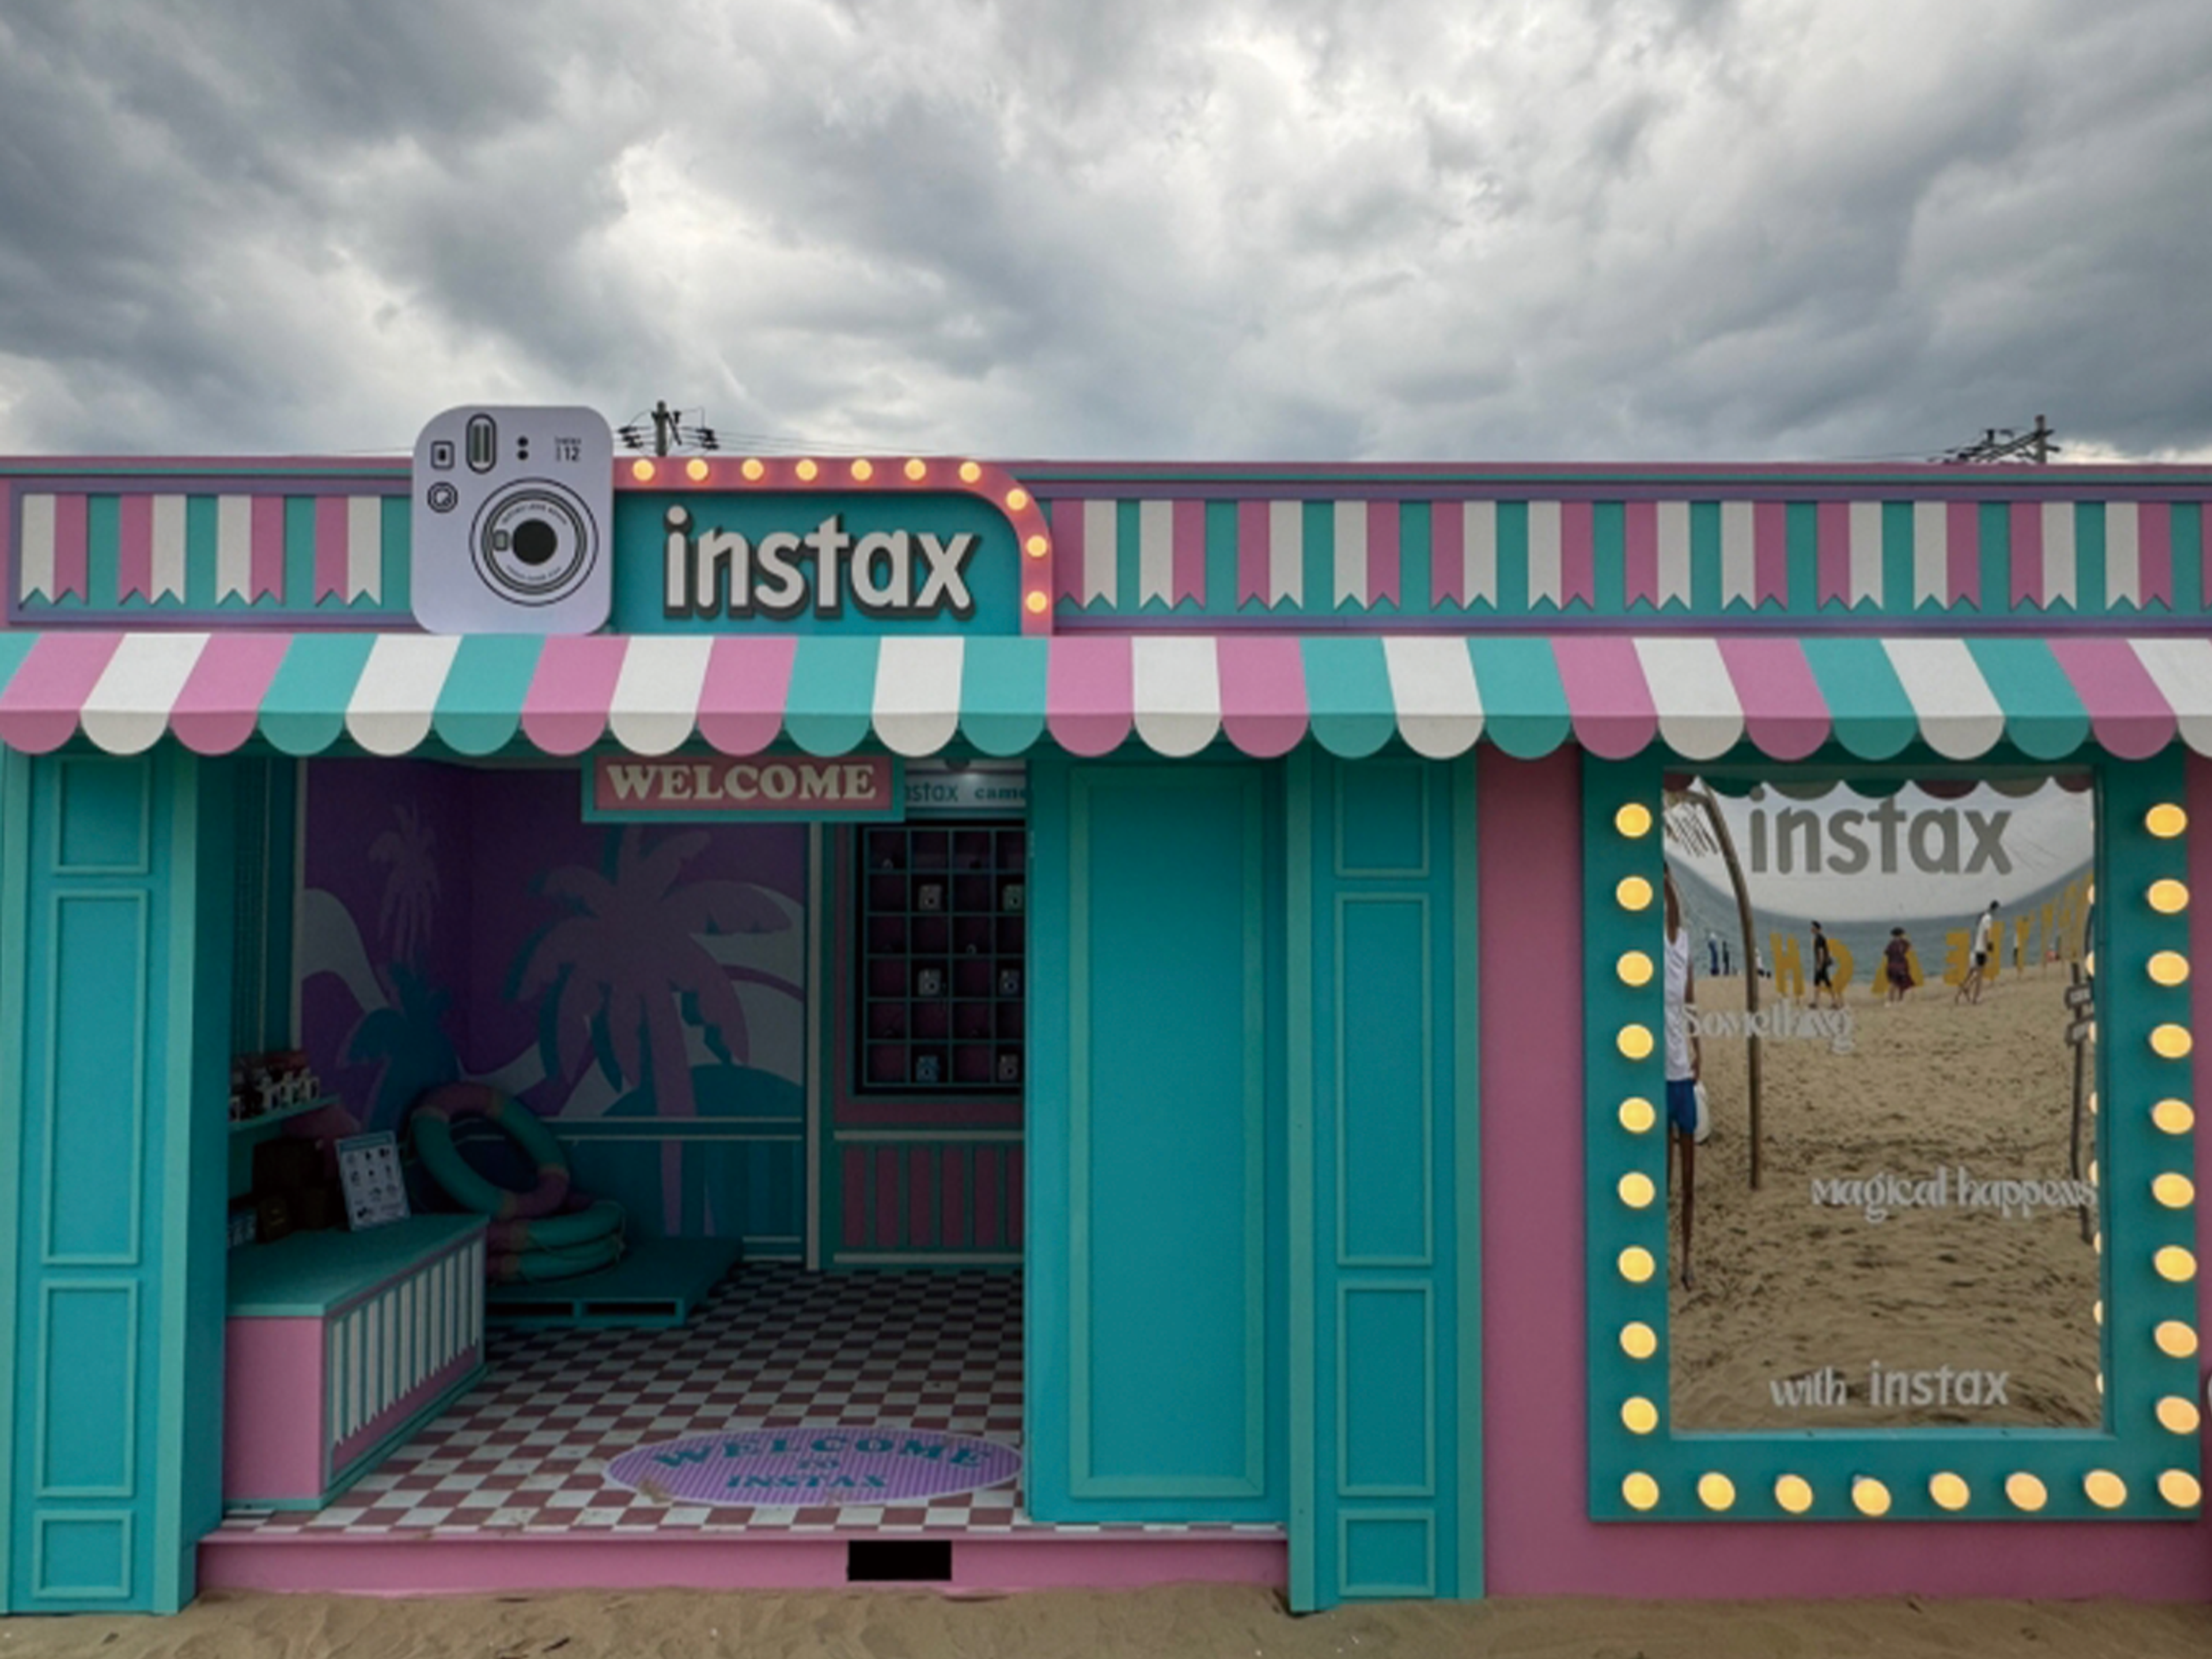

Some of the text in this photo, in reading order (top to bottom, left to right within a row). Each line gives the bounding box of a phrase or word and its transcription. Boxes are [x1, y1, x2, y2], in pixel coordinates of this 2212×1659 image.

[664, 505, 976, 619] instax
[607, 764, 876, 800] WELCOME
[1749, 785, 2013, 874] instax
[1770, 1358, 2009, 1407] with instax
[652, 1438, 992, 1469] WELCOME
[726, 1475, 887, 1488] INSTAX
